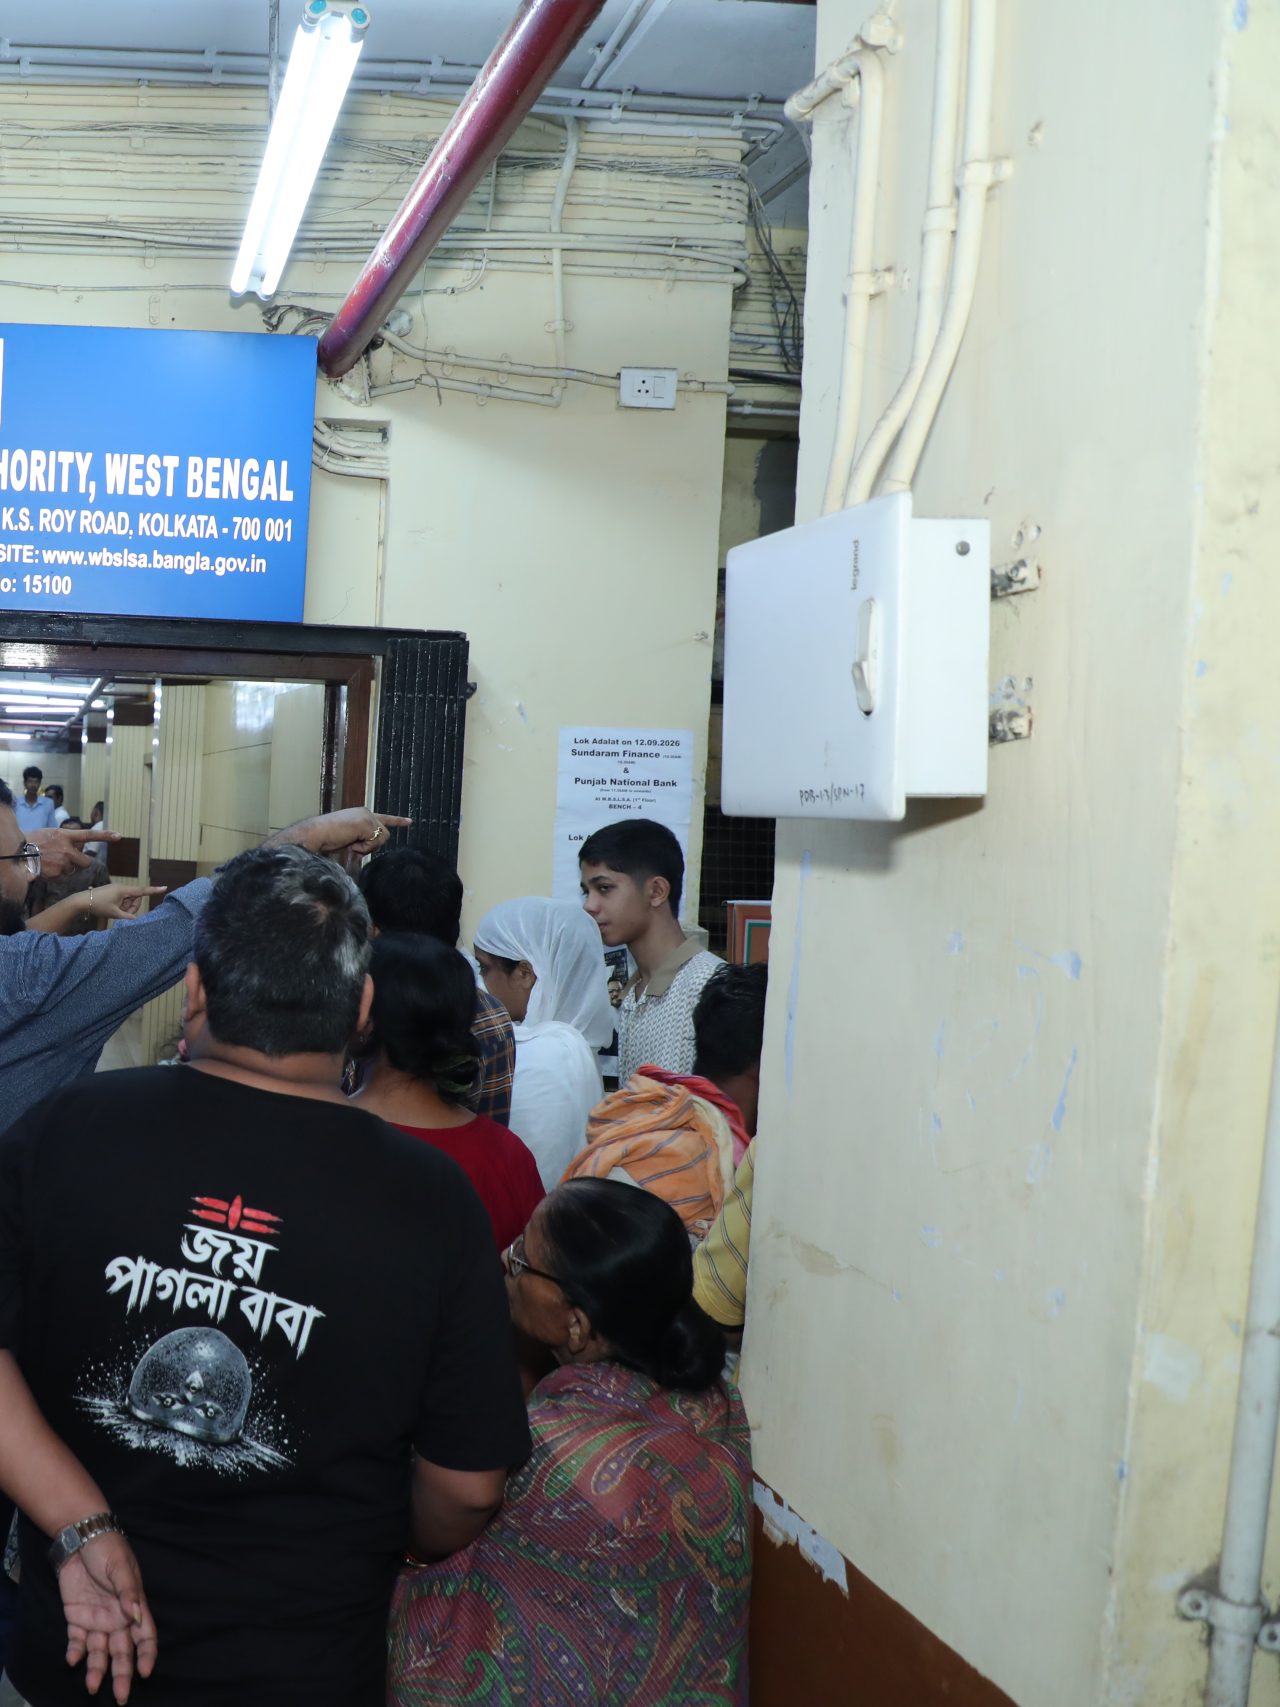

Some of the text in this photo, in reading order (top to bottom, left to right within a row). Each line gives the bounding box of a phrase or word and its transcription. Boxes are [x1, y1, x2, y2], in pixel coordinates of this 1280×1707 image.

[104, 452, 180, 498] WEST
[186, 455, 294, 502] BENGAL
[1, 506, 35, 533] K.S.
[38, 507, 78, 534] ROY
[79, 509, 134, 540] ROAD,
[137, 511, 219, 539] KOLKATA
[232, 516, 261, 542] 700
[264, 517, 292, 542] 001
[42, 546, 267, 577] www.wbslsa.bangla.gov.in
[851, 539, 859, 591] legrand
[22, 573, 73, 598] 15100
[571, 748, 620, 757] Sundaram
[622, 750, 660, 758] Finance
[592, 738, 619, 746] Adalat
[635, 739, 680, 747] 12.09.2026
[574, 777, 677, 787] Punjab National Bank
[180, 1223, 280, 1285] জয়
[105, 1255, 326, 1360] পাগলা বাবা
